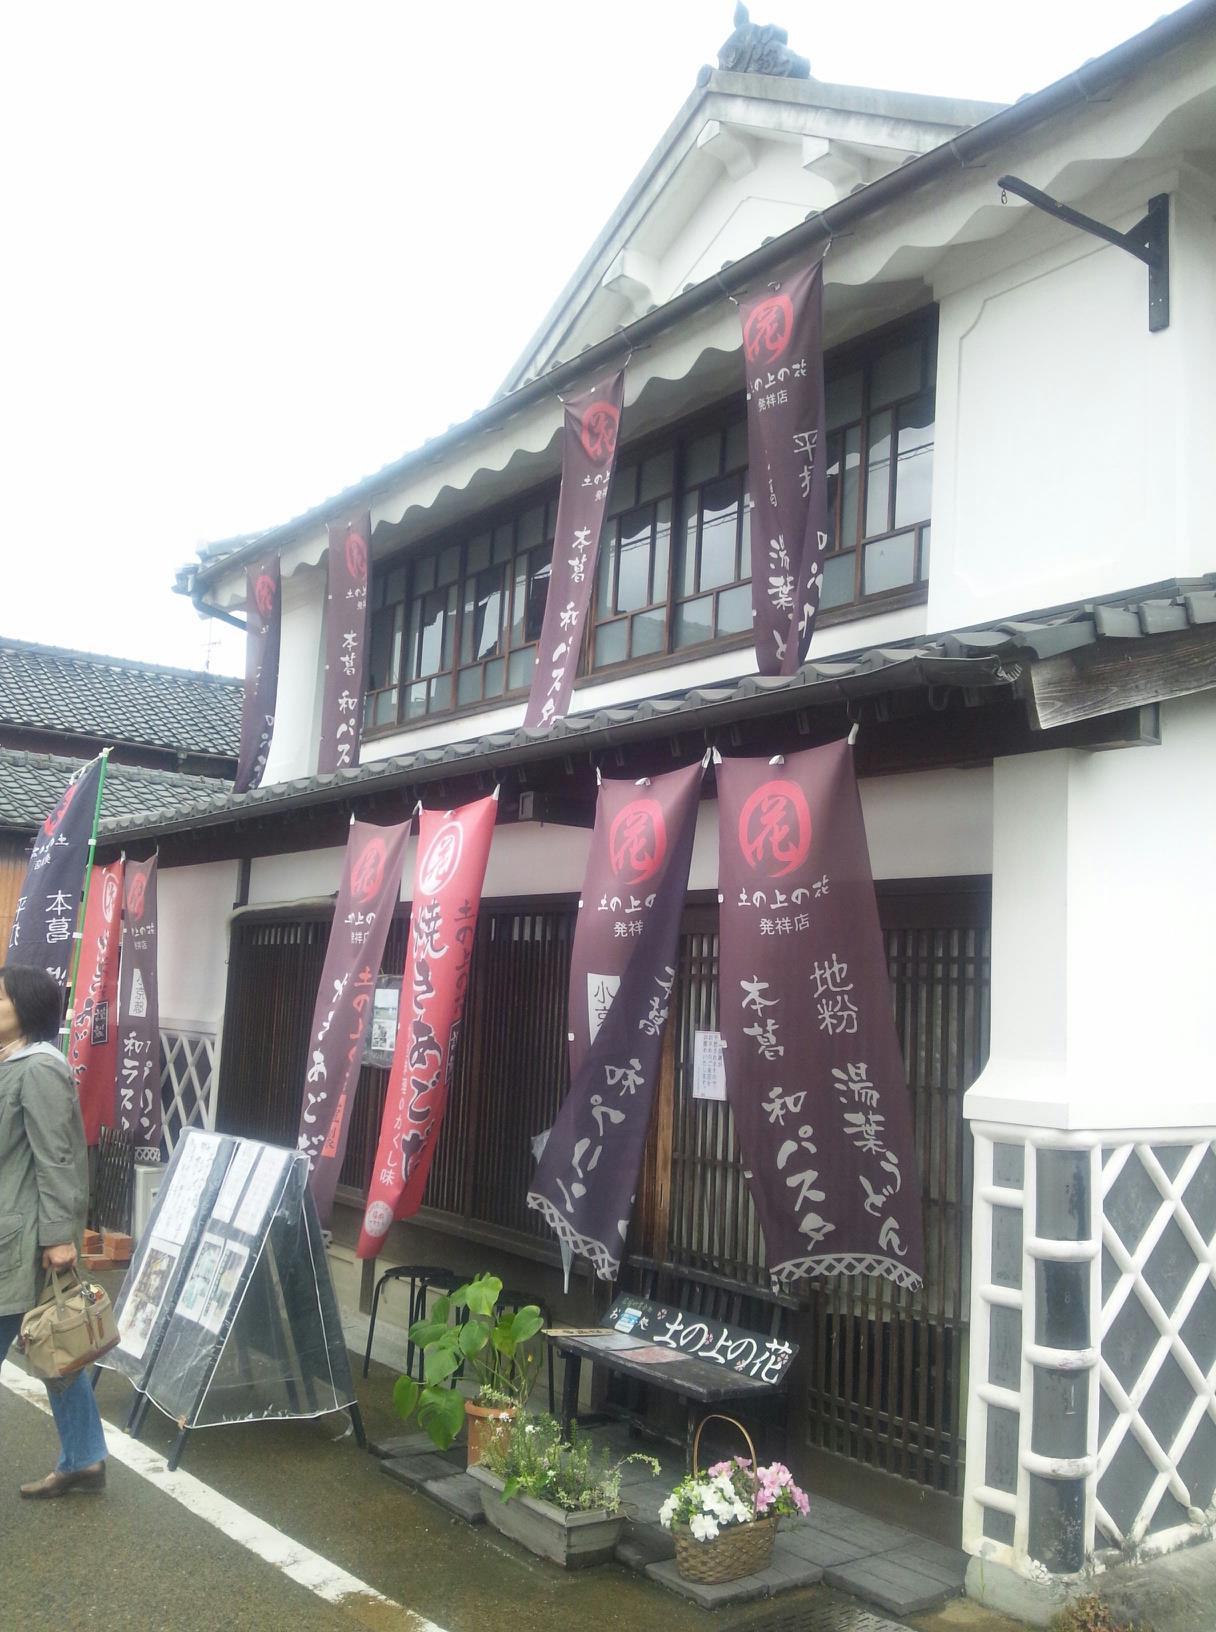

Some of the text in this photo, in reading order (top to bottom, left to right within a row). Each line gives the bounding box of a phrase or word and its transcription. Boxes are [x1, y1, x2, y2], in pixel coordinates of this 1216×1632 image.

[750, 359, 807, 393] の上の花
[738, 875, 831, 909] 土の上の花
[760, 913, 810, 936] 発祥店
[740, 975, 836, 1250] 本葛 和パスタ
[810, 953, 908, 1256] 地粉 湯葉うどん
[653, 1312, 793, 1384] 土の上の花
